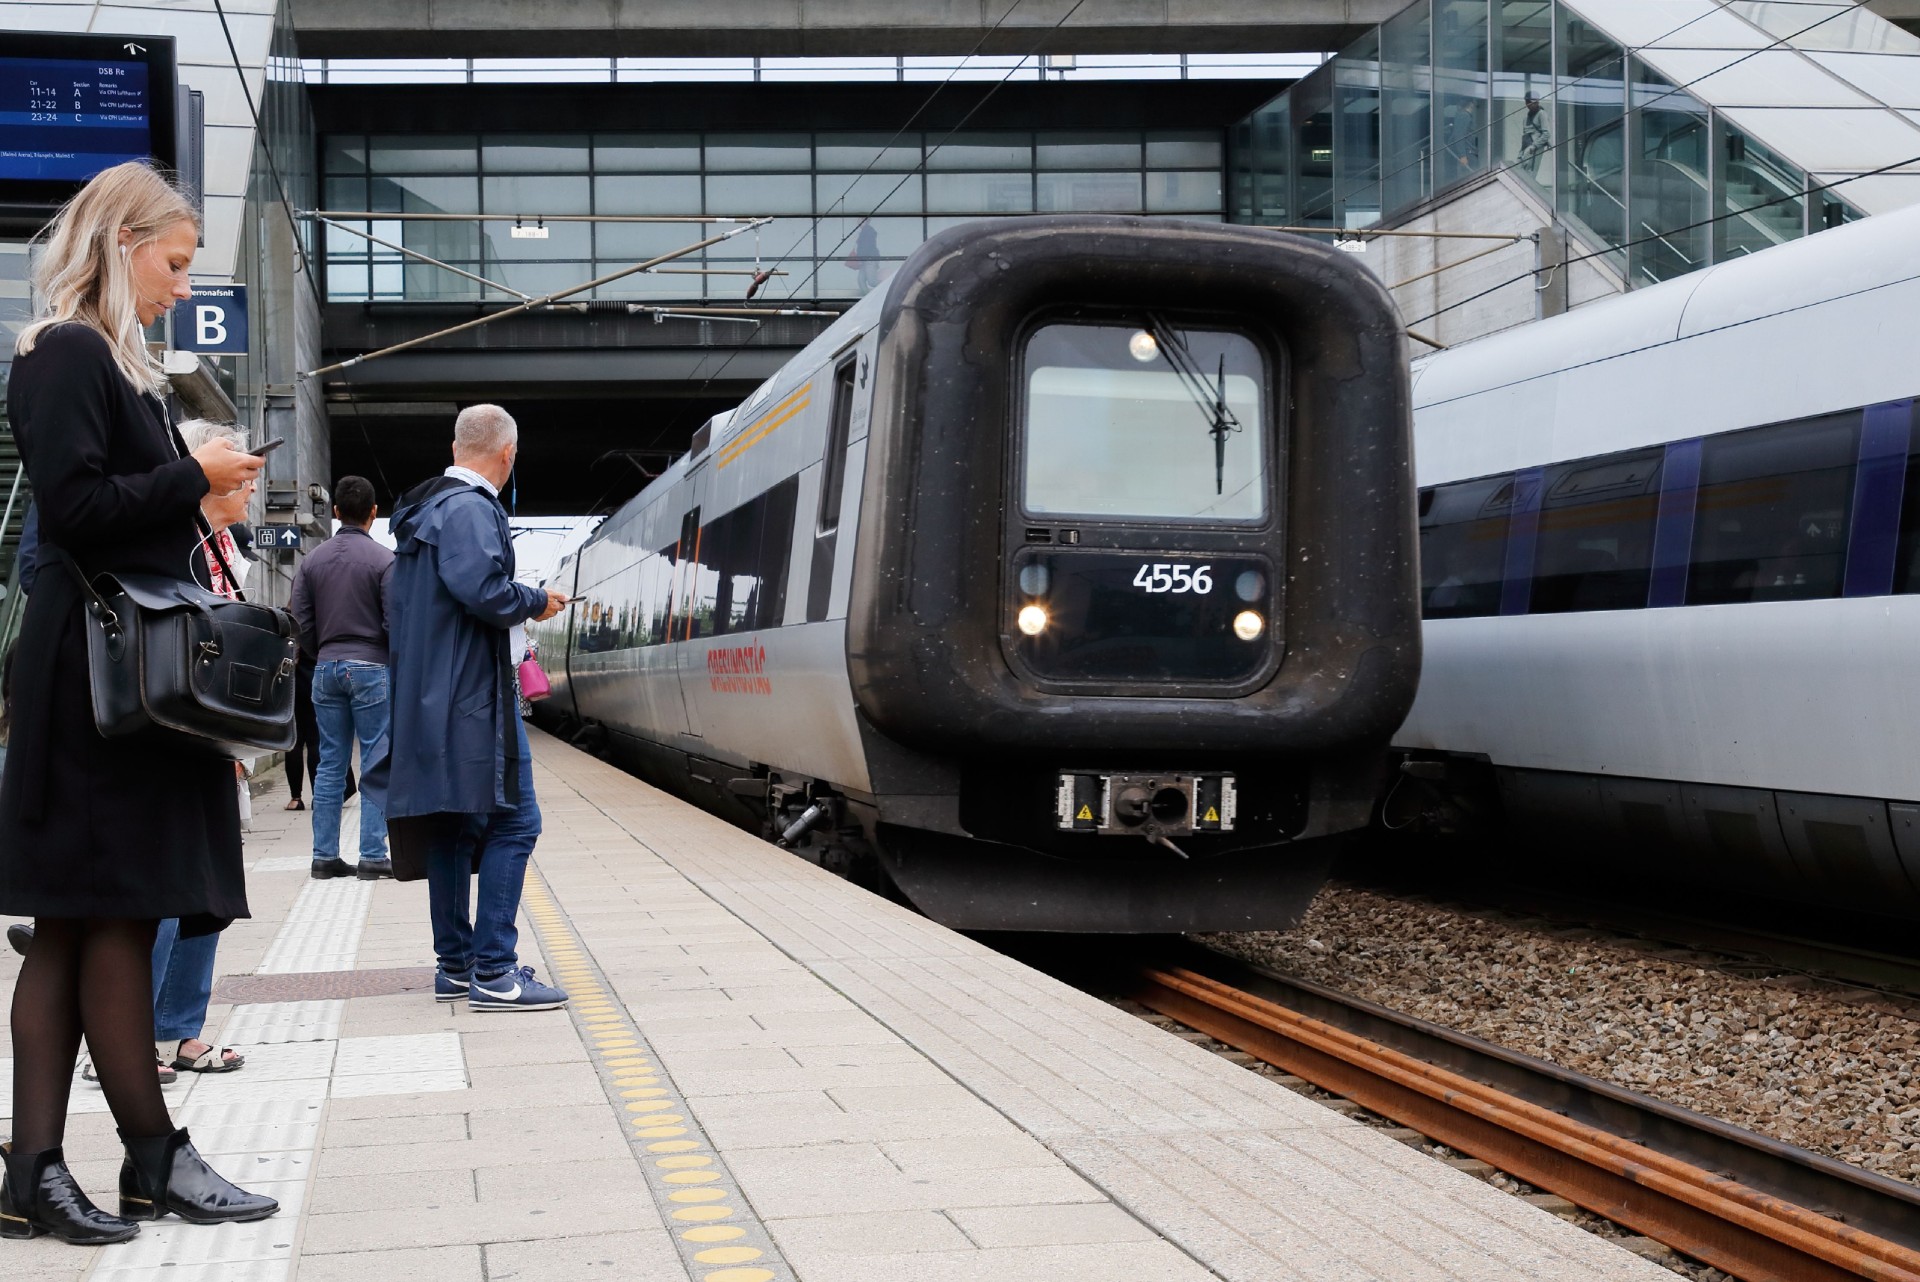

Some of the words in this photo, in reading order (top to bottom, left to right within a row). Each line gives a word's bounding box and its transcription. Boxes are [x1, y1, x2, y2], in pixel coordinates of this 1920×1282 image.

[31, 87, 56, 96] 11-14
[74, 88, 81, 97] A
[31, 100, 57, 109] 21-22
[75, 101, 81, 109] B
[31, 112, 58, 121] 23-24
[75, 113, 82, 122] C
[190, 289, 234, 297] erronafsnit
[196, 305, 227, 344] B
[1133, 564, 1213, 594] 4556
